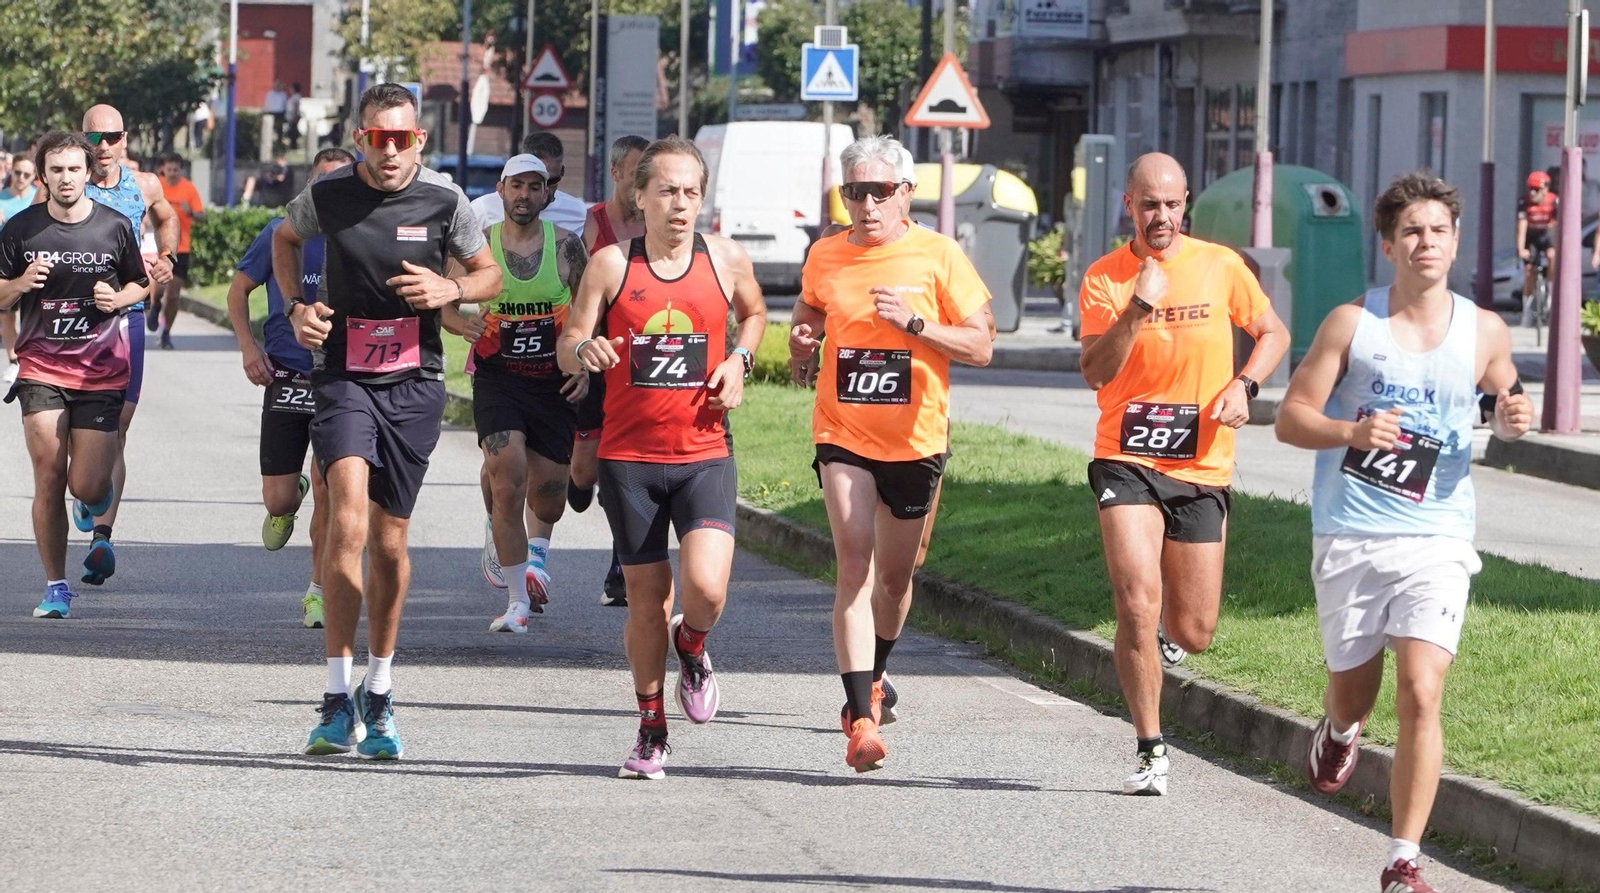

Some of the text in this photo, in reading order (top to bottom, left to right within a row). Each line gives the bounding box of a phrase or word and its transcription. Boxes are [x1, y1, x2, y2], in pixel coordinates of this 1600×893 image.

[536, 102, 558, 117] 30
[72, 265, 94, 274] Since
[498, 302, 554, 316] 3NORTH
[52, 317, 90, 335] 174
[363, 341, 402, 364] 713
[511, 335, 543, 354] 55
[649, 356, 688, 378] 74
[847, 371, 901, 394] 106
[1126, 426, 1192, 450] 287
[1361, 446, 1418, 484] 141
